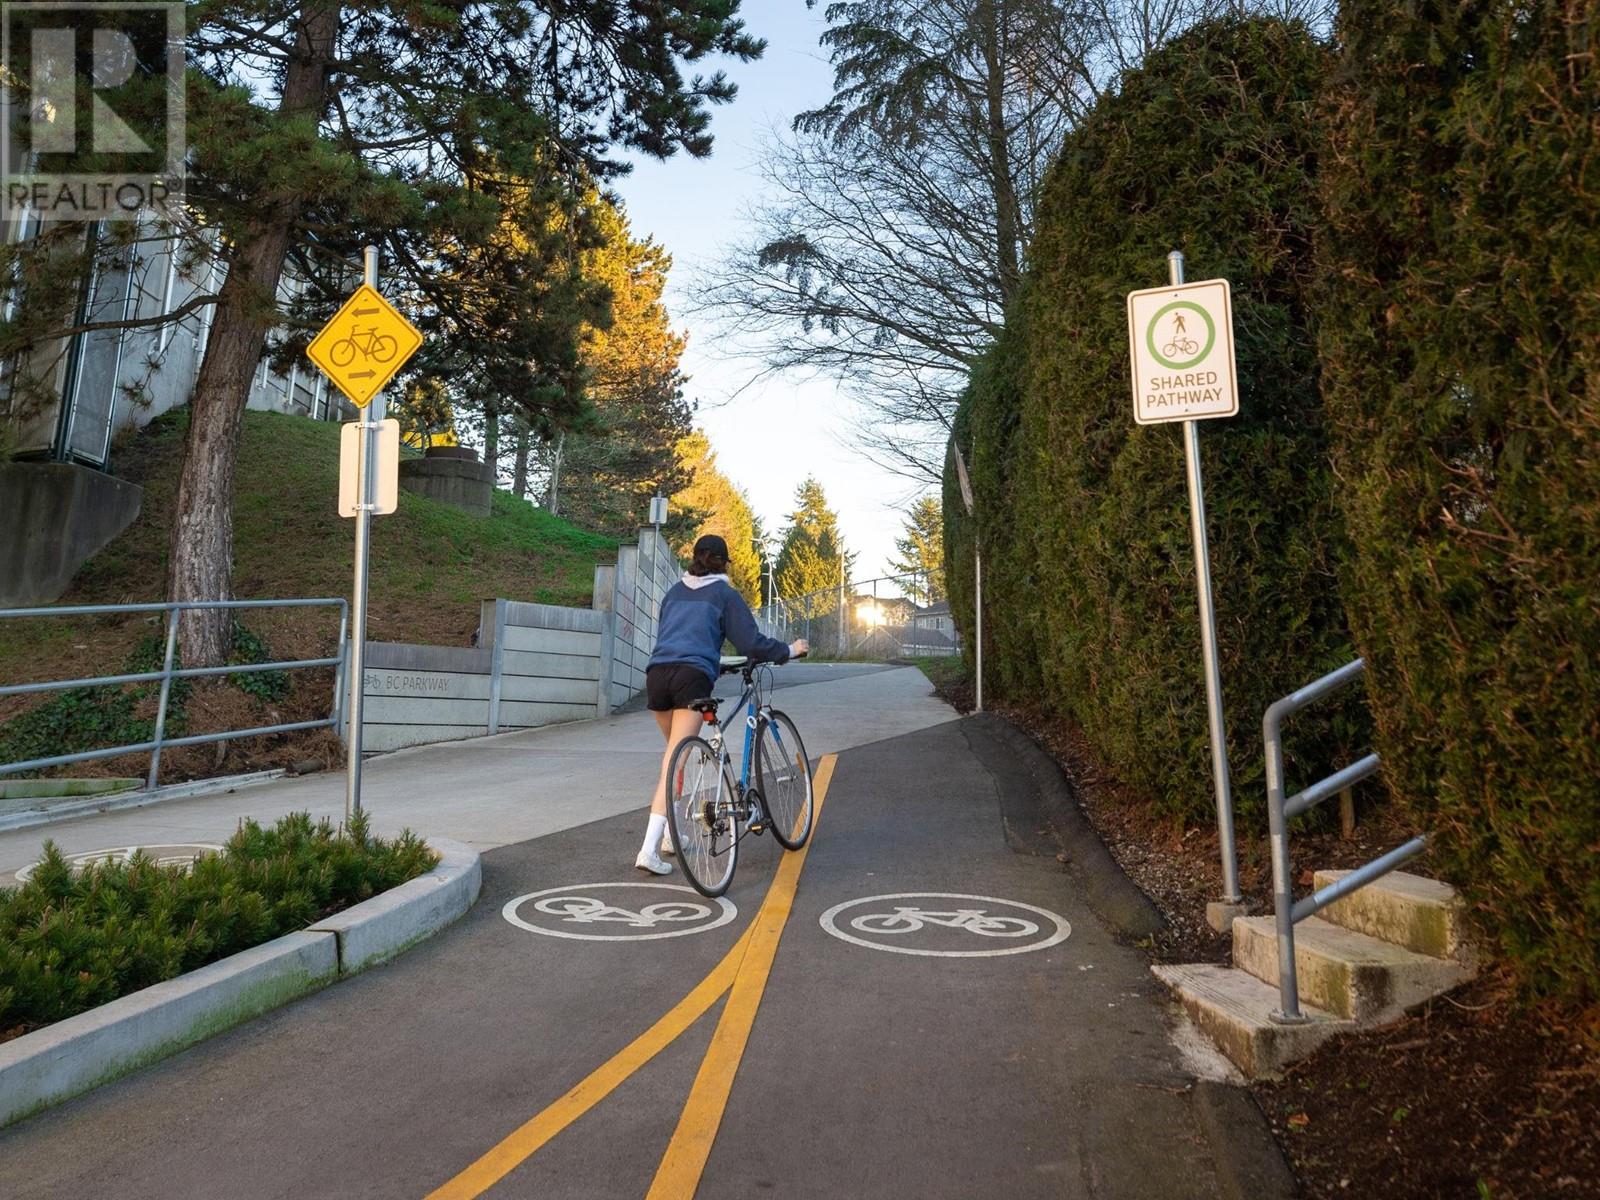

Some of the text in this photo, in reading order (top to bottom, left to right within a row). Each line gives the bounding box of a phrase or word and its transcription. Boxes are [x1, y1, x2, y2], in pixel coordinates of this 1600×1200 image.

[1150, 371, 1217, 391] SHARED
[1146, 388, 1223, 408] PATHWAY
[386, 675, 450, 691] BC PARKWAY
